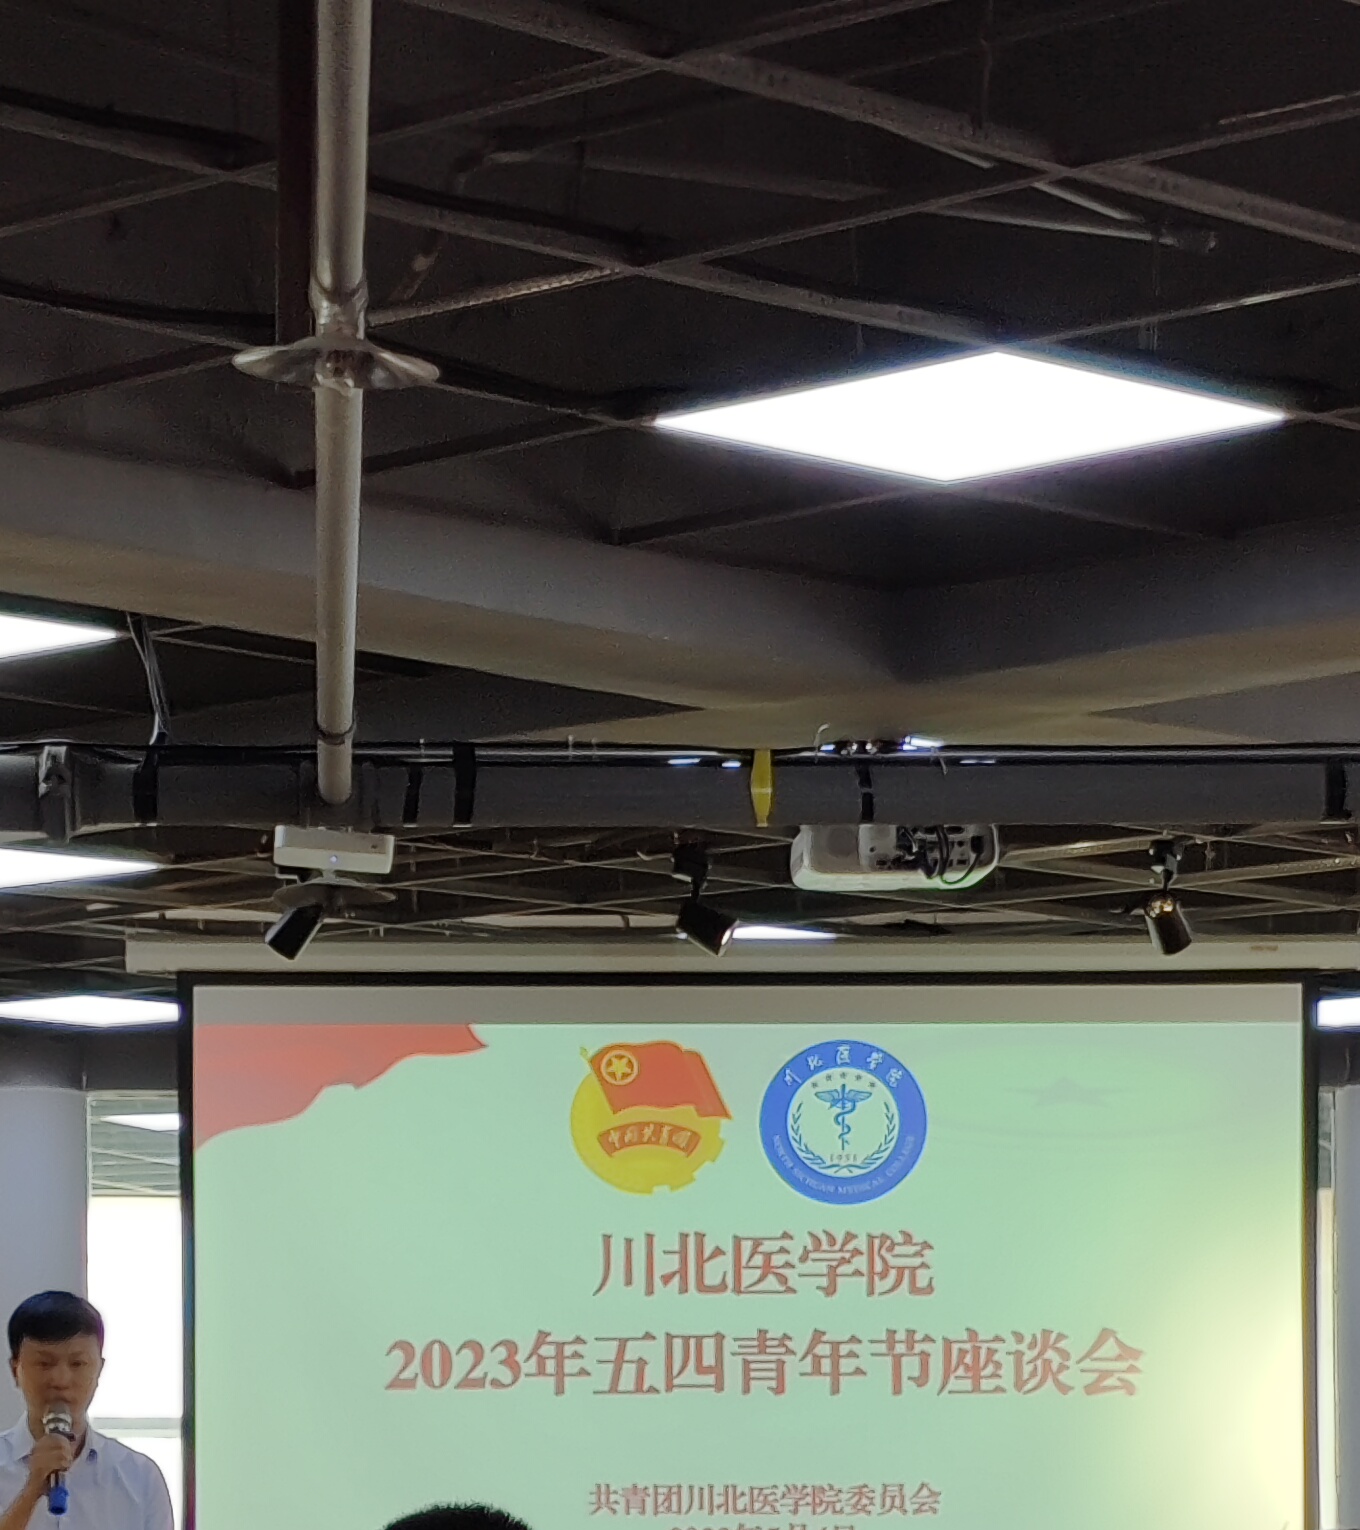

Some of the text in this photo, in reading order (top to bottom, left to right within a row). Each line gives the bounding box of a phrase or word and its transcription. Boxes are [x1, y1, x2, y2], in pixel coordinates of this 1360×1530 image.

[592, 1231, 935, 1298] 川北医学院
[385, 1328, 1144, 1397] 2023年五四青年节座谈会
[589, 1484, 942, 1517] 共青团川北医学院委员会
